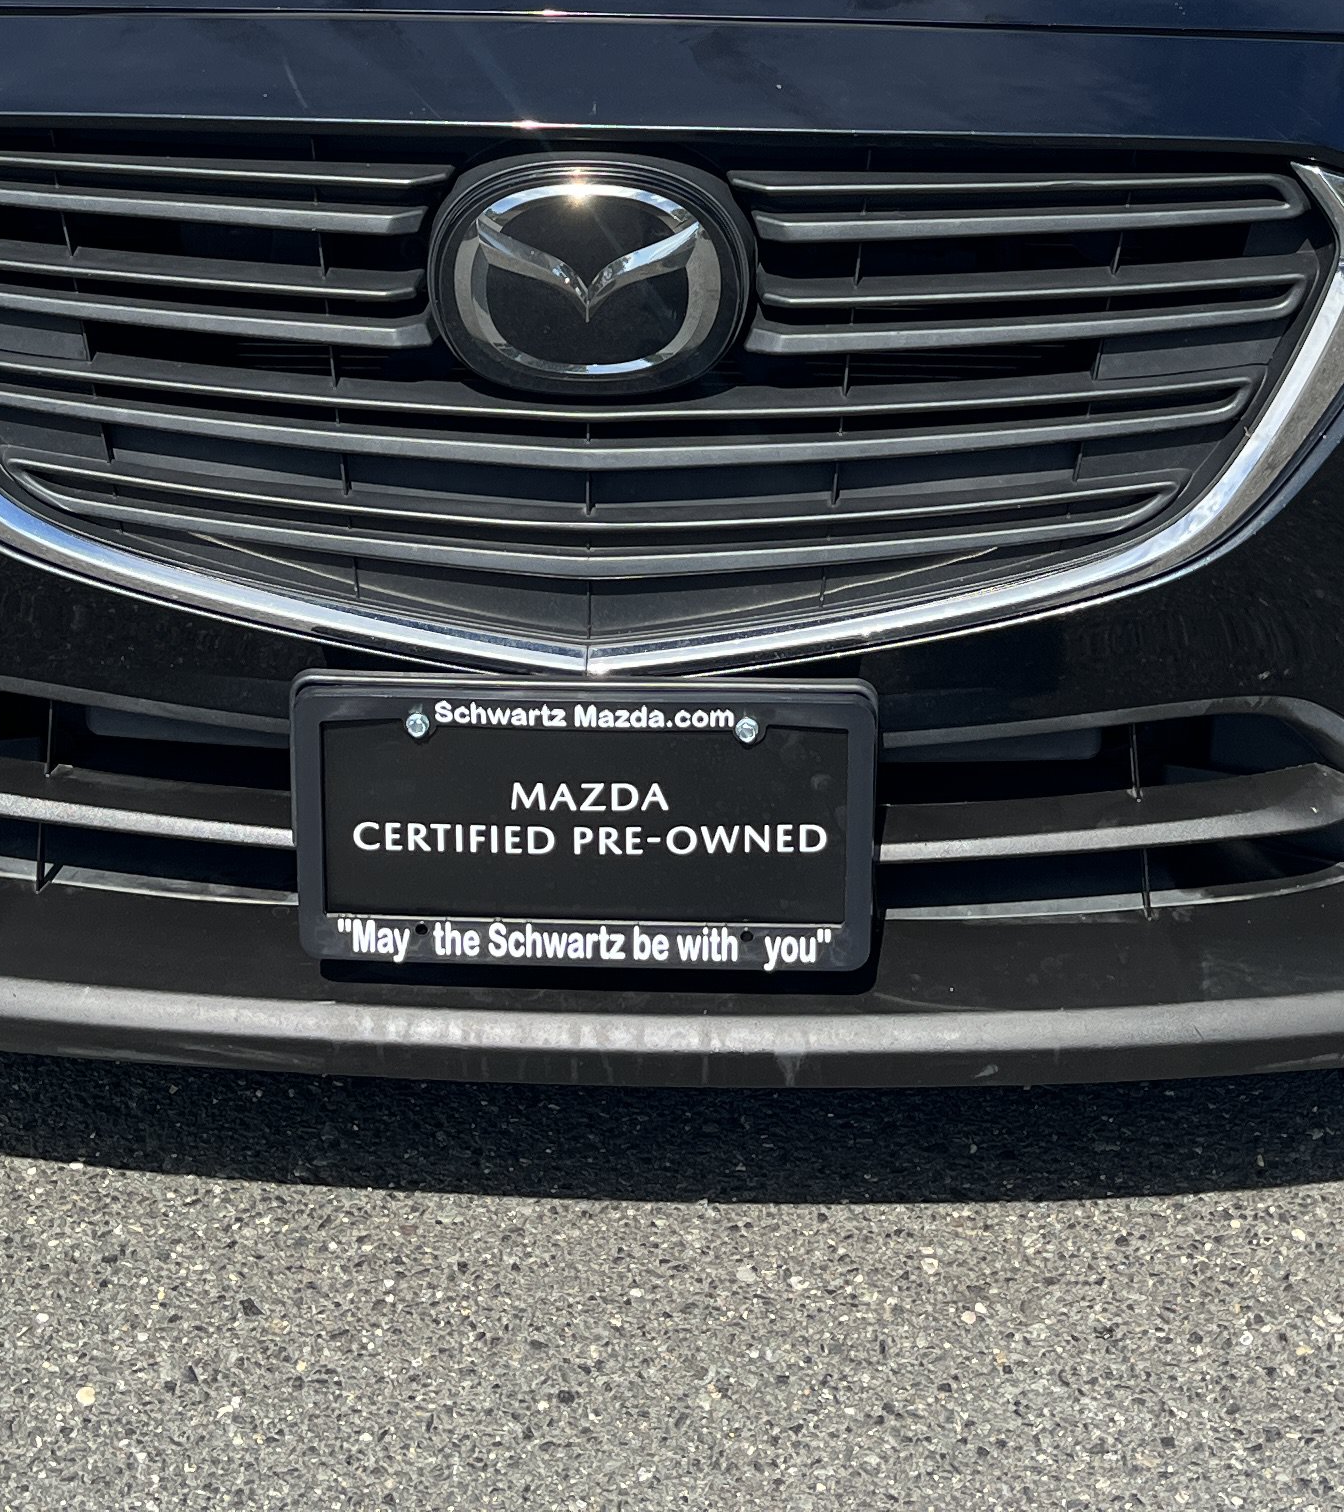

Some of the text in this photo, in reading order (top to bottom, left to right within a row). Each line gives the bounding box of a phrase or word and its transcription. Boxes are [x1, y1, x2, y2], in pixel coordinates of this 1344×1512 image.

[435, 701, 735, 730] Schwartz Mazda.com
[510, 783, 669, 812] MAZDA
[352, 821, 828, 856] CERTIFIED PRE-OWNED
[338, 920, 832, 972] "May the Schwartz be with you"
